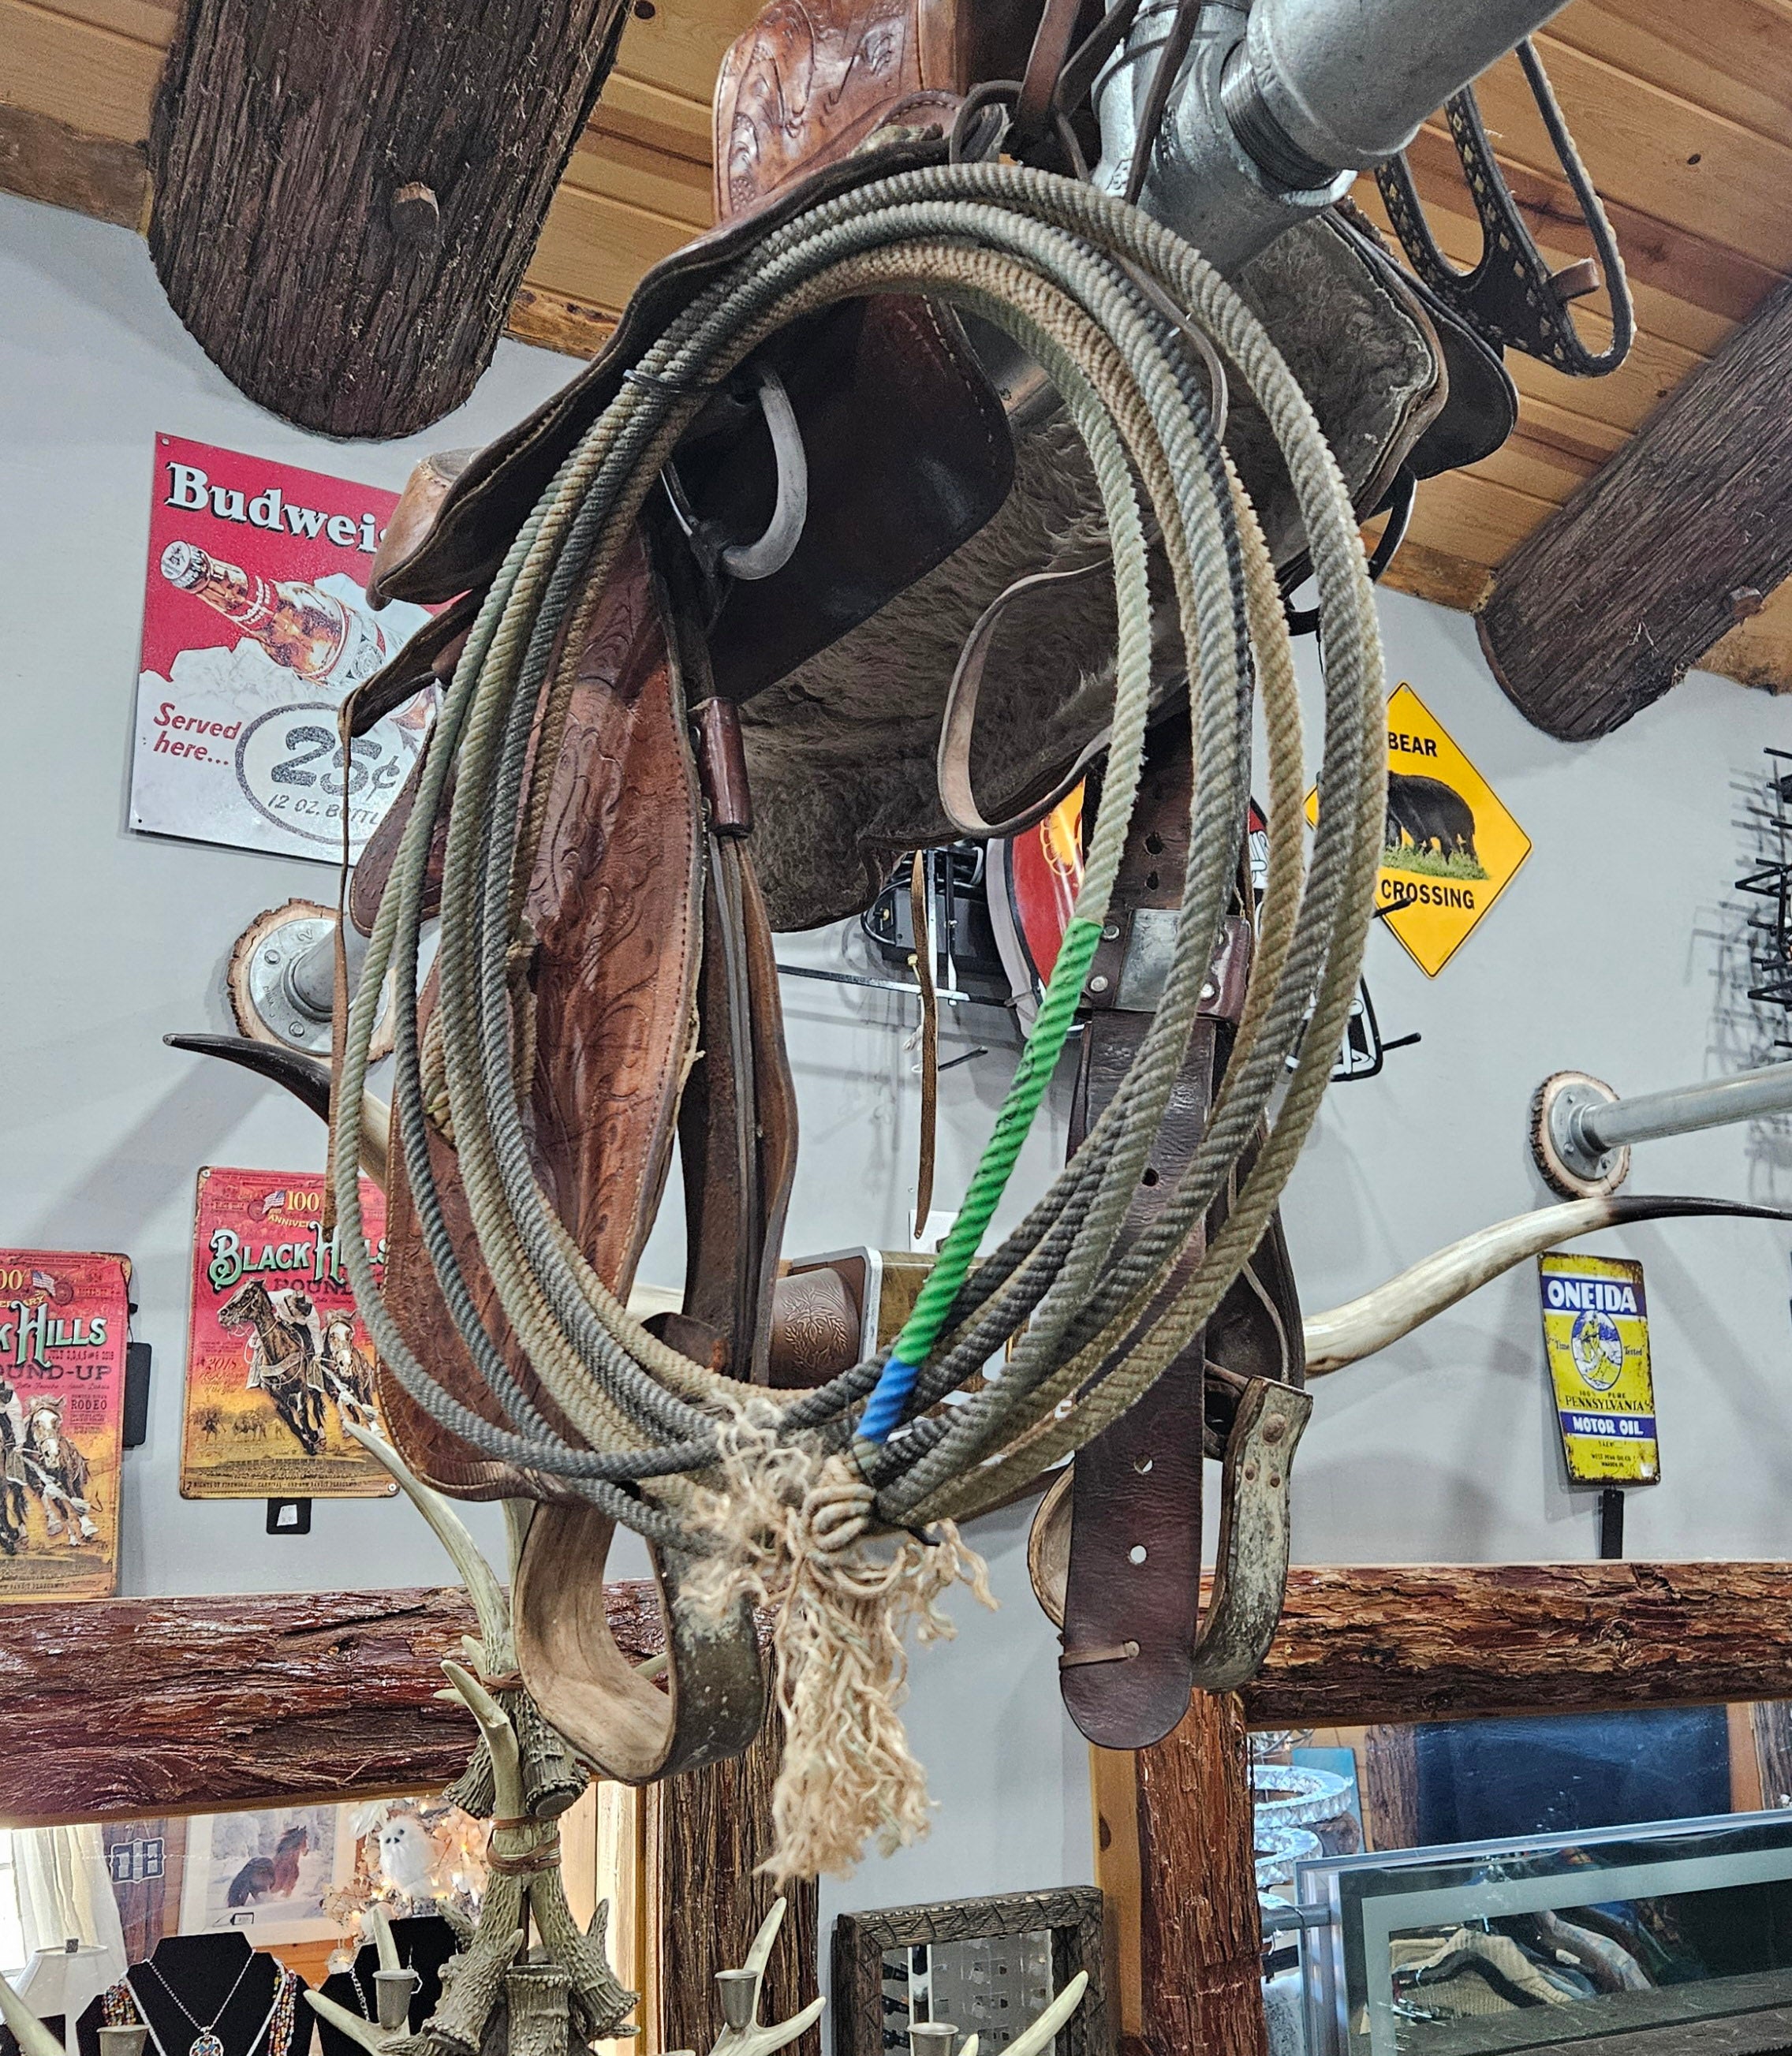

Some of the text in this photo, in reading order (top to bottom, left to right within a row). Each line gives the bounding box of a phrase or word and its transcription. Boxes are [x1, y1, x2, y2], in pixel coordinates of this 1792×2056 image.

[153, 702, 242, 740] Served
[153, 730, 229, 766] here...
[1388, 732, 1438, 758] BEAR
[267, 793, 290, 810] 12
[1381, 879, 1475, 910] CROSSING
[287, 1189, 320, 1213] 100
[208, 1228, 312, 1291] BLACK
[1547, 1280, 1637, 1313] ONEIDA
[10, 1300, 108, 1369] HILLS
[71, 1399, 107, 1410] RODEO
[1565, 1395, 1645, 1412] PENNSYLVANIA
[1572, 1416, 1645, 1435] MOTOR OIL
